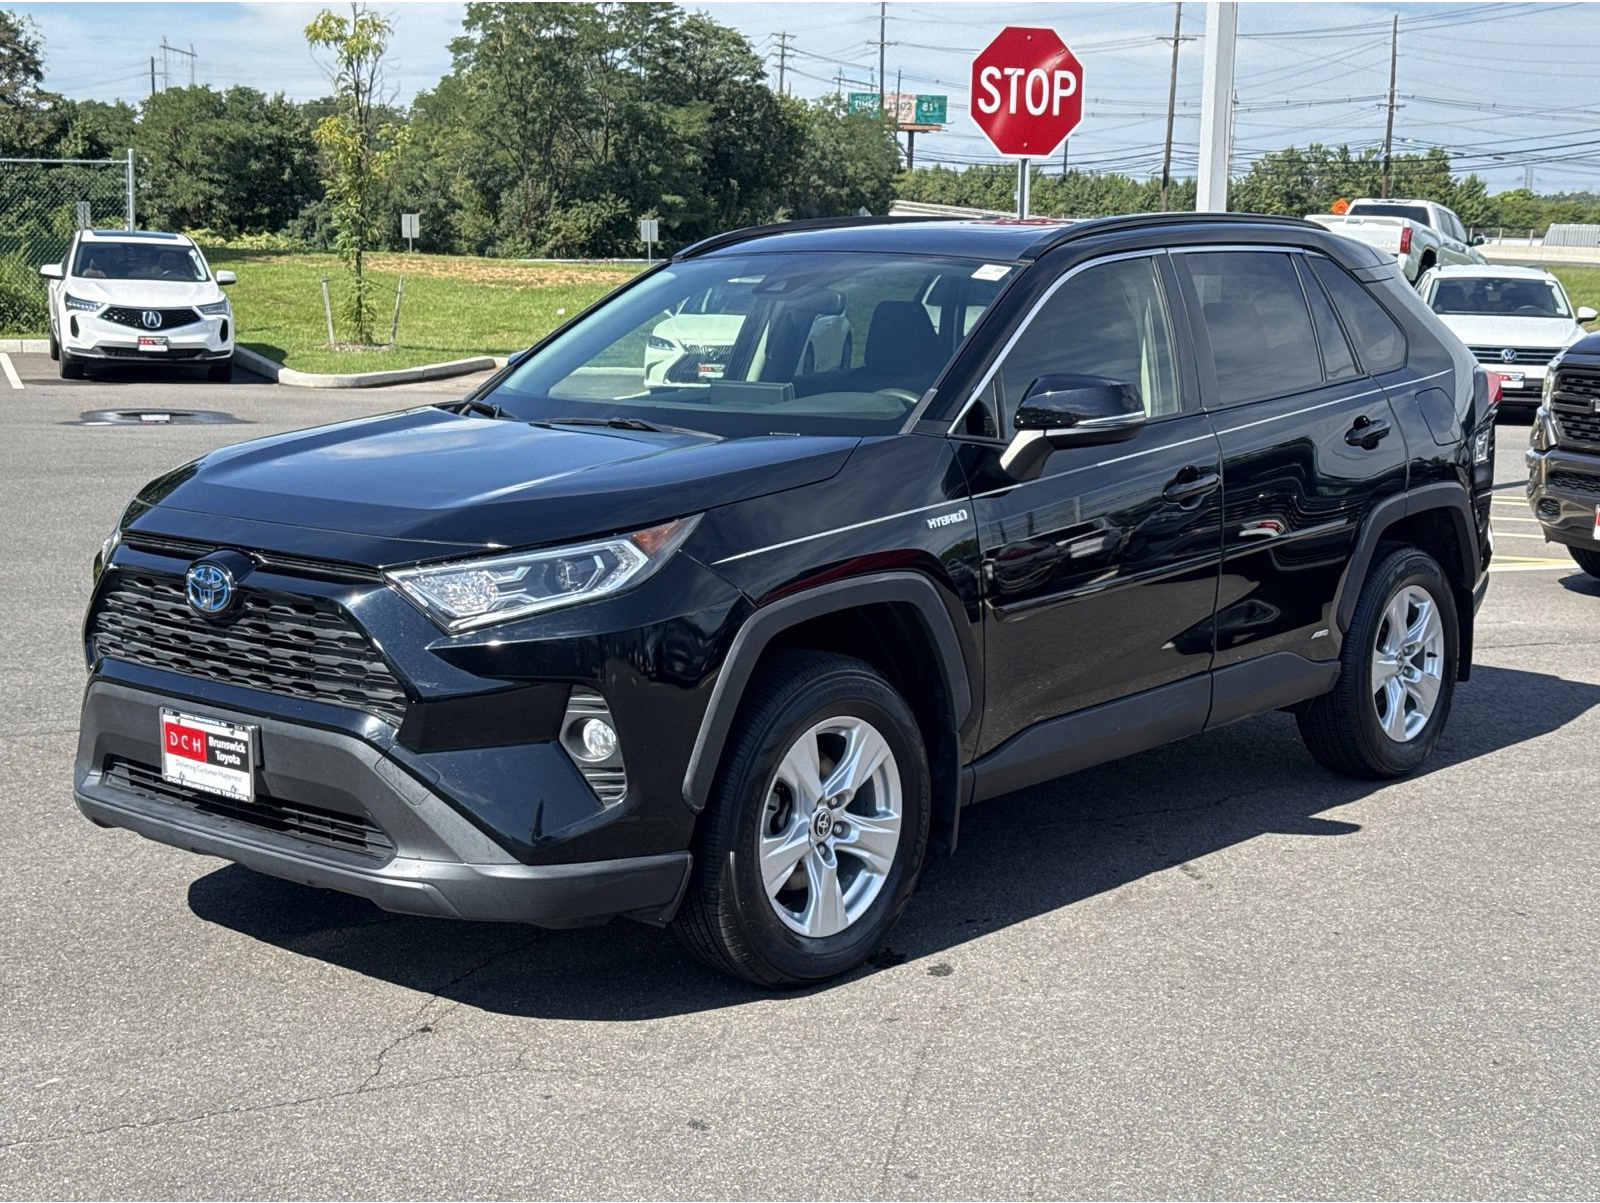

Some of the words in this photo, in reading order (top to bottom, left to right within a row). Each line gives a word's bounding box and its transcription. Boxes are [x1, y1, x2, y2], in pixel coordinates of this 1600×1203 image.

[977, 65, 1077, 116] STOP
[926, 509, 968, 529] HYBRID
[208, 735, 246, 754] Brunswick
[215, 750, 241, 765] Toyota
